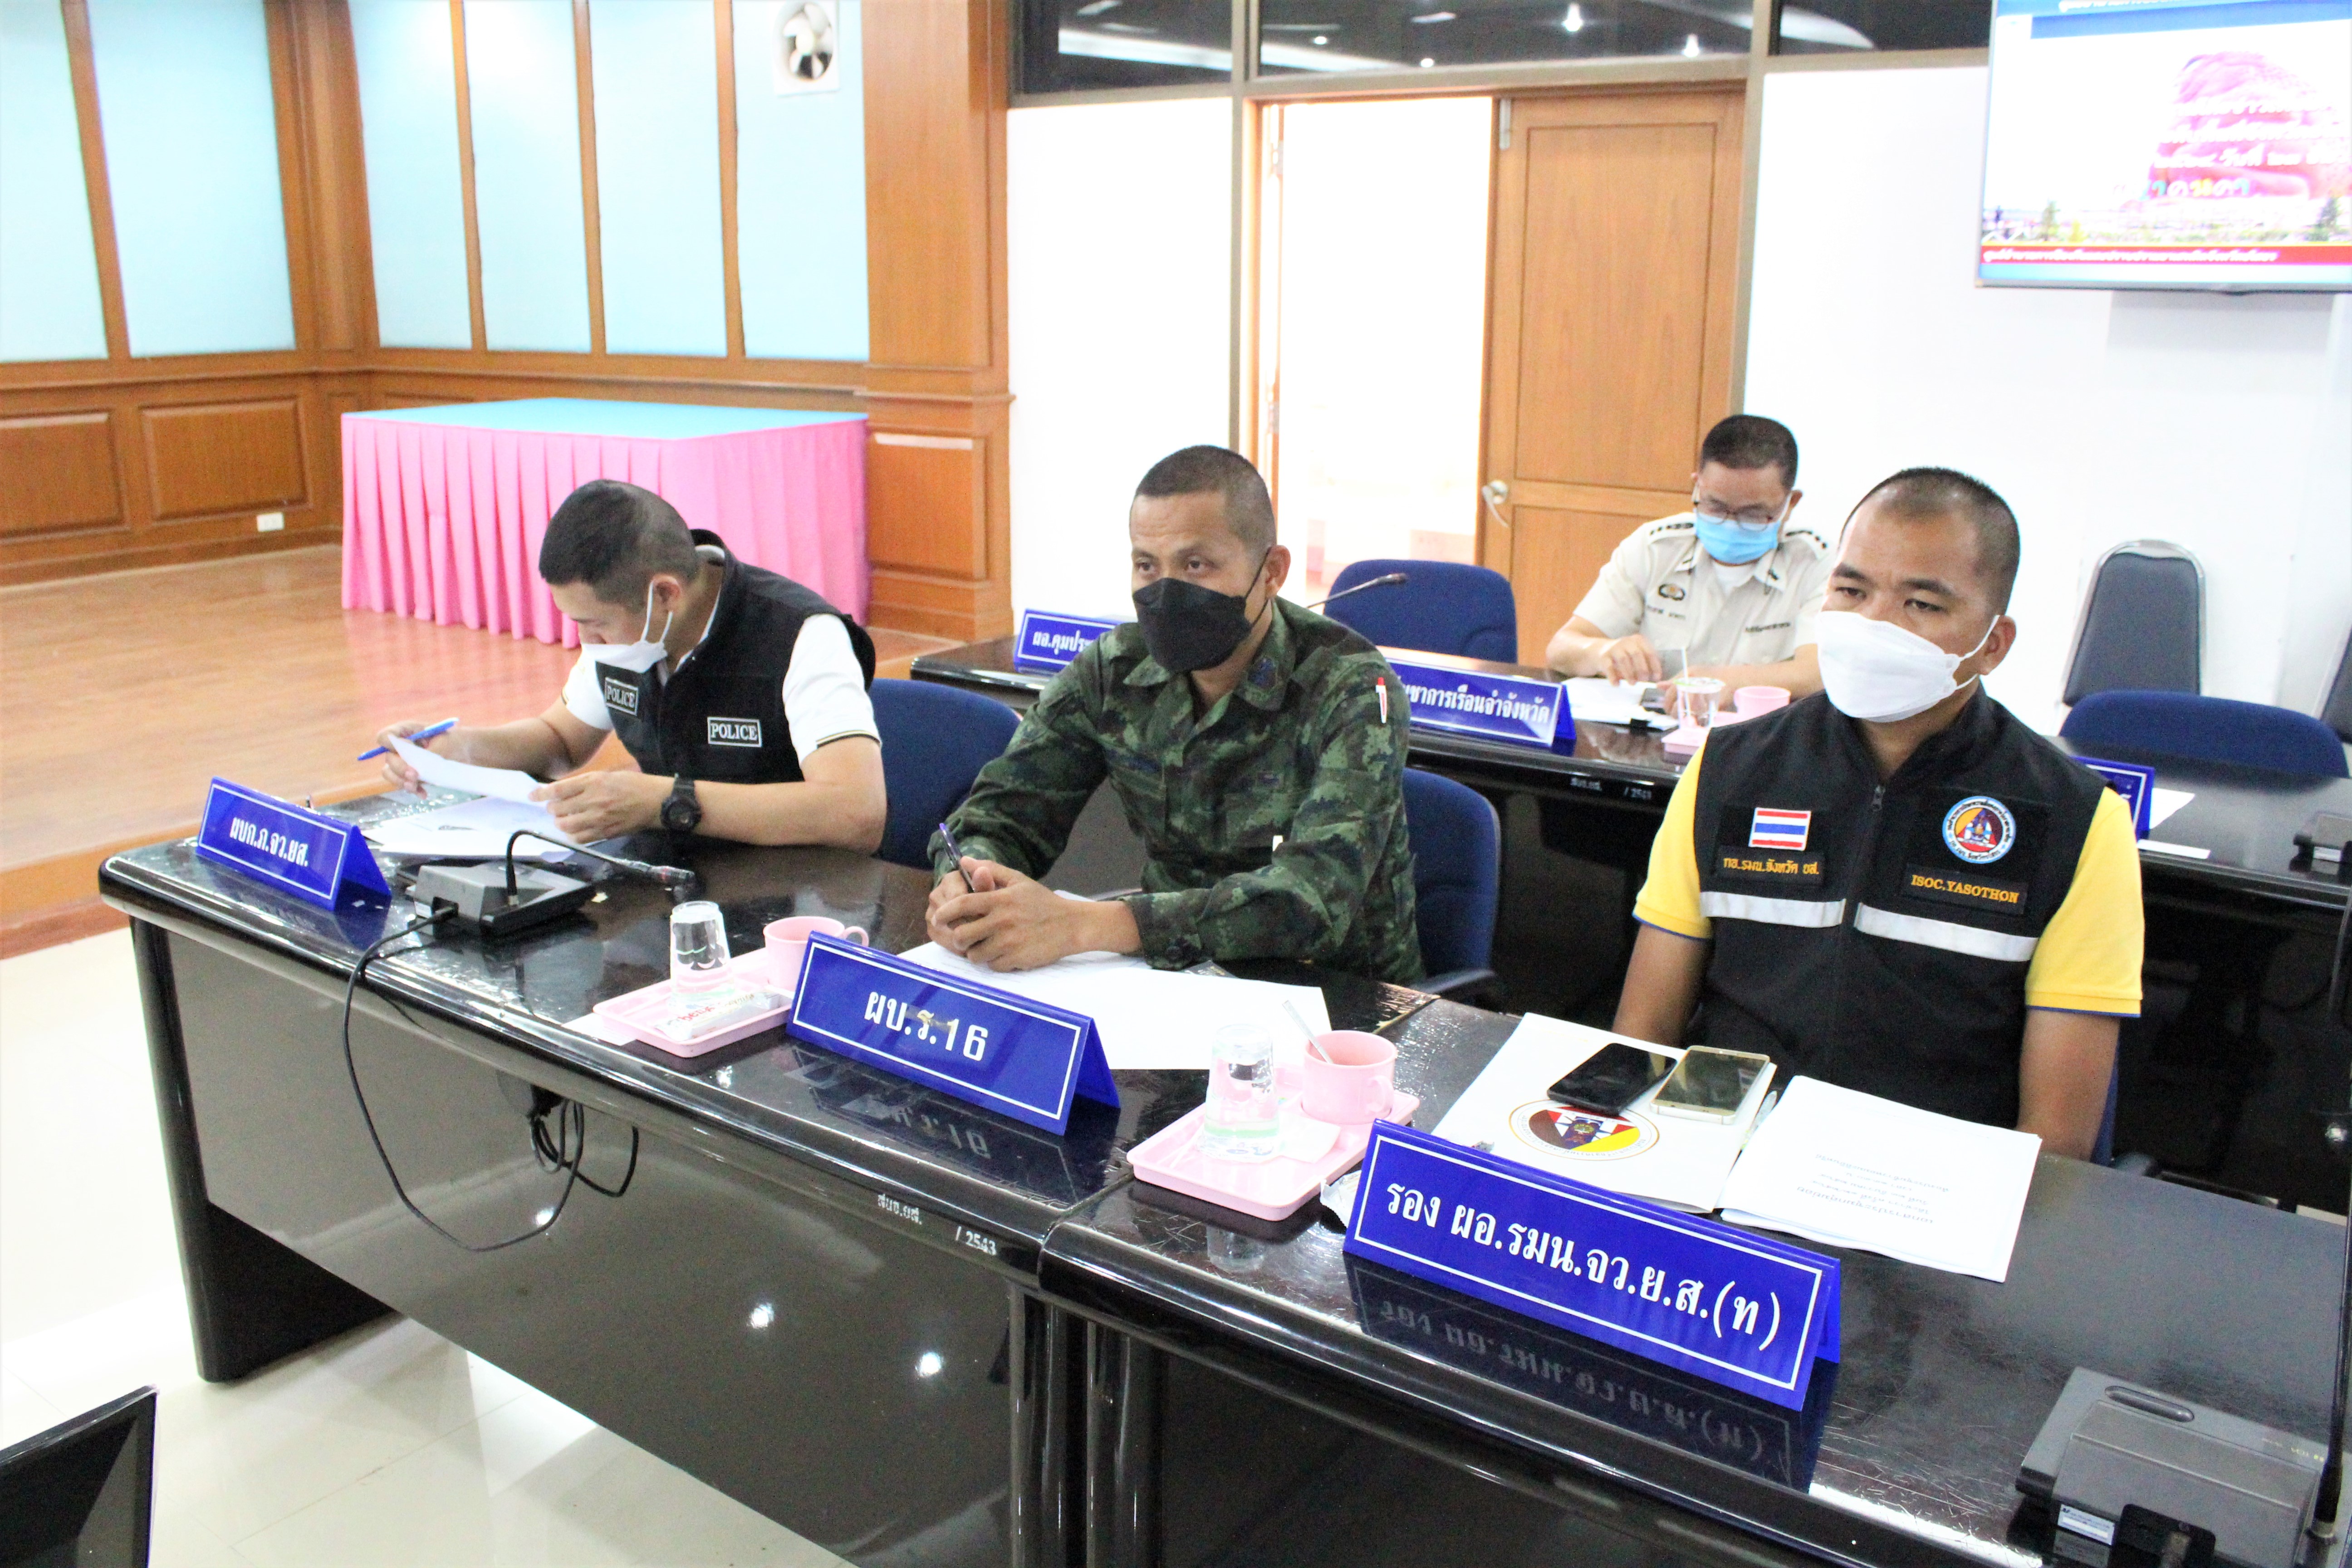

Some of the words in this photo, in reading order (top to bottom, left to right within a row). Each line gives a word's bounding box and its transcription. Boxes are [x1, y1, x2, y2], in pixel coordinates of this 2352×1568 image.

[607, 686, 636, 708] POLICE
[710, 723, 758, 741] POLICE
[230, 817, 309, 867] ผบก.ภ.จว.ยส.
[1911, 873, 2020, 904] ISOC.YASOTHON
[1385, 1181, 1442, 1229] รอง
